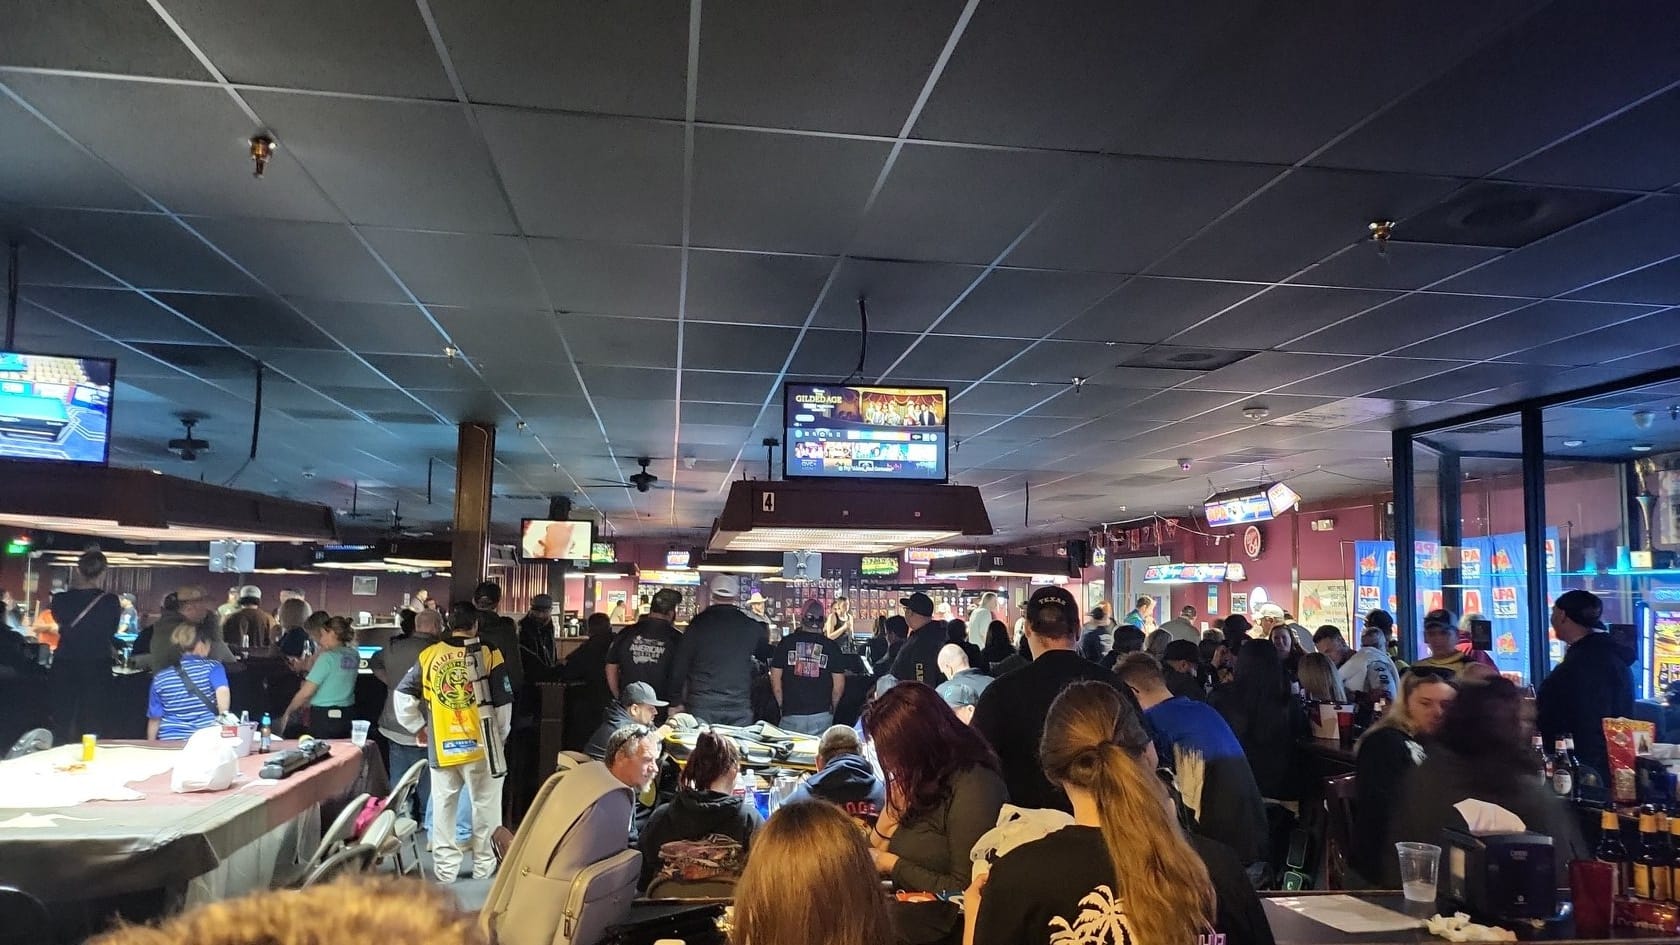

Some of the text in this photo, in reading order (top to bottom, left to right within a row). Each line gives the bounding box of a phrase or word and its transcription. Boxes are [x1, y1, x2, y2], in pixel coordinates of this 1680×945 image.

[795, 395, 842, 404] GILDED AGE
[764, 493, 773, 511] 4
[1038, 596, 1066, 606] TEXAS
[629, 643, 666, 655] AMERICAN
[431, 652, 452, 672] BLUE
